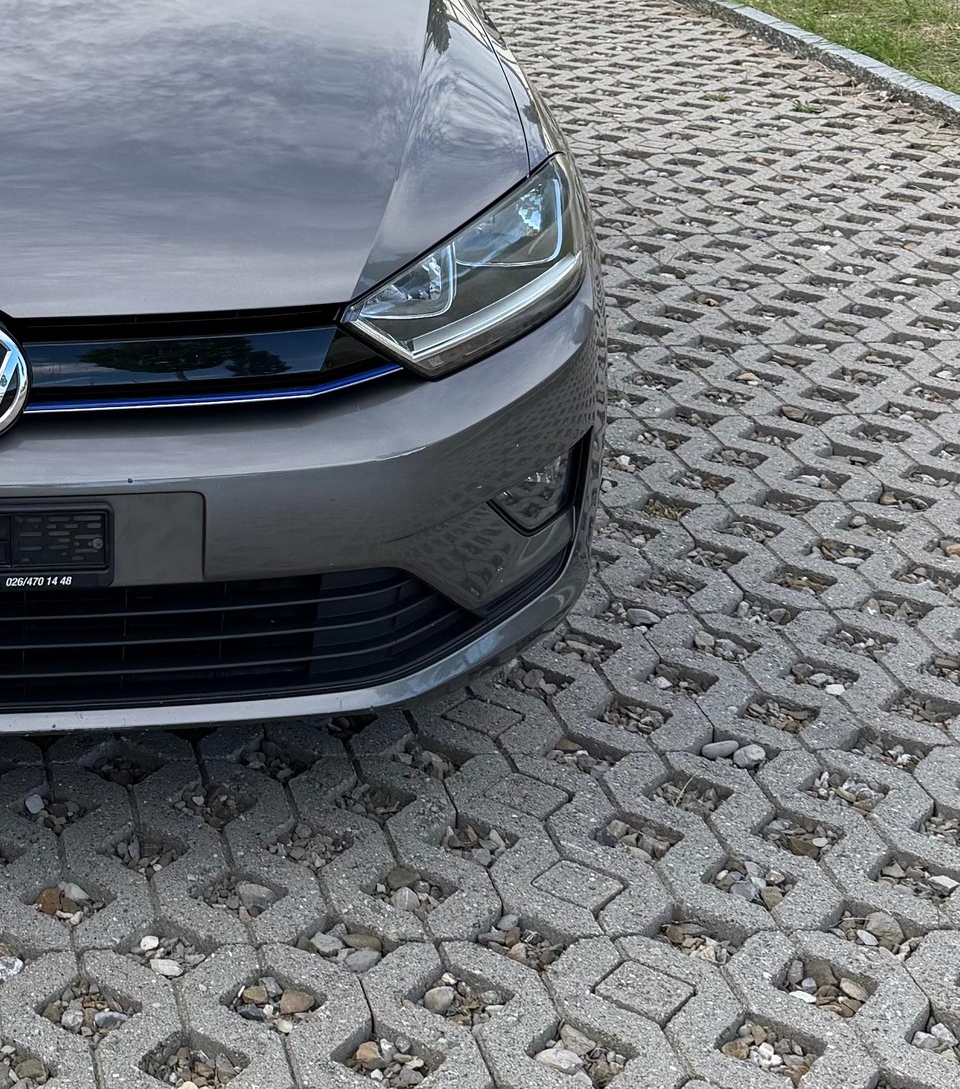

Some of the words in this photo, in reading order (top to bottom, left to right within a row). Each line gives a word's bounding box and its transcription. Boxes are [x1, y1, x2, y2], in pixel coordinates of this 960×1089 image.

[5, 576, 45, 587] 026/470
[46, 576, 59, 586] 14
[59, 575, 73, 586] 48
